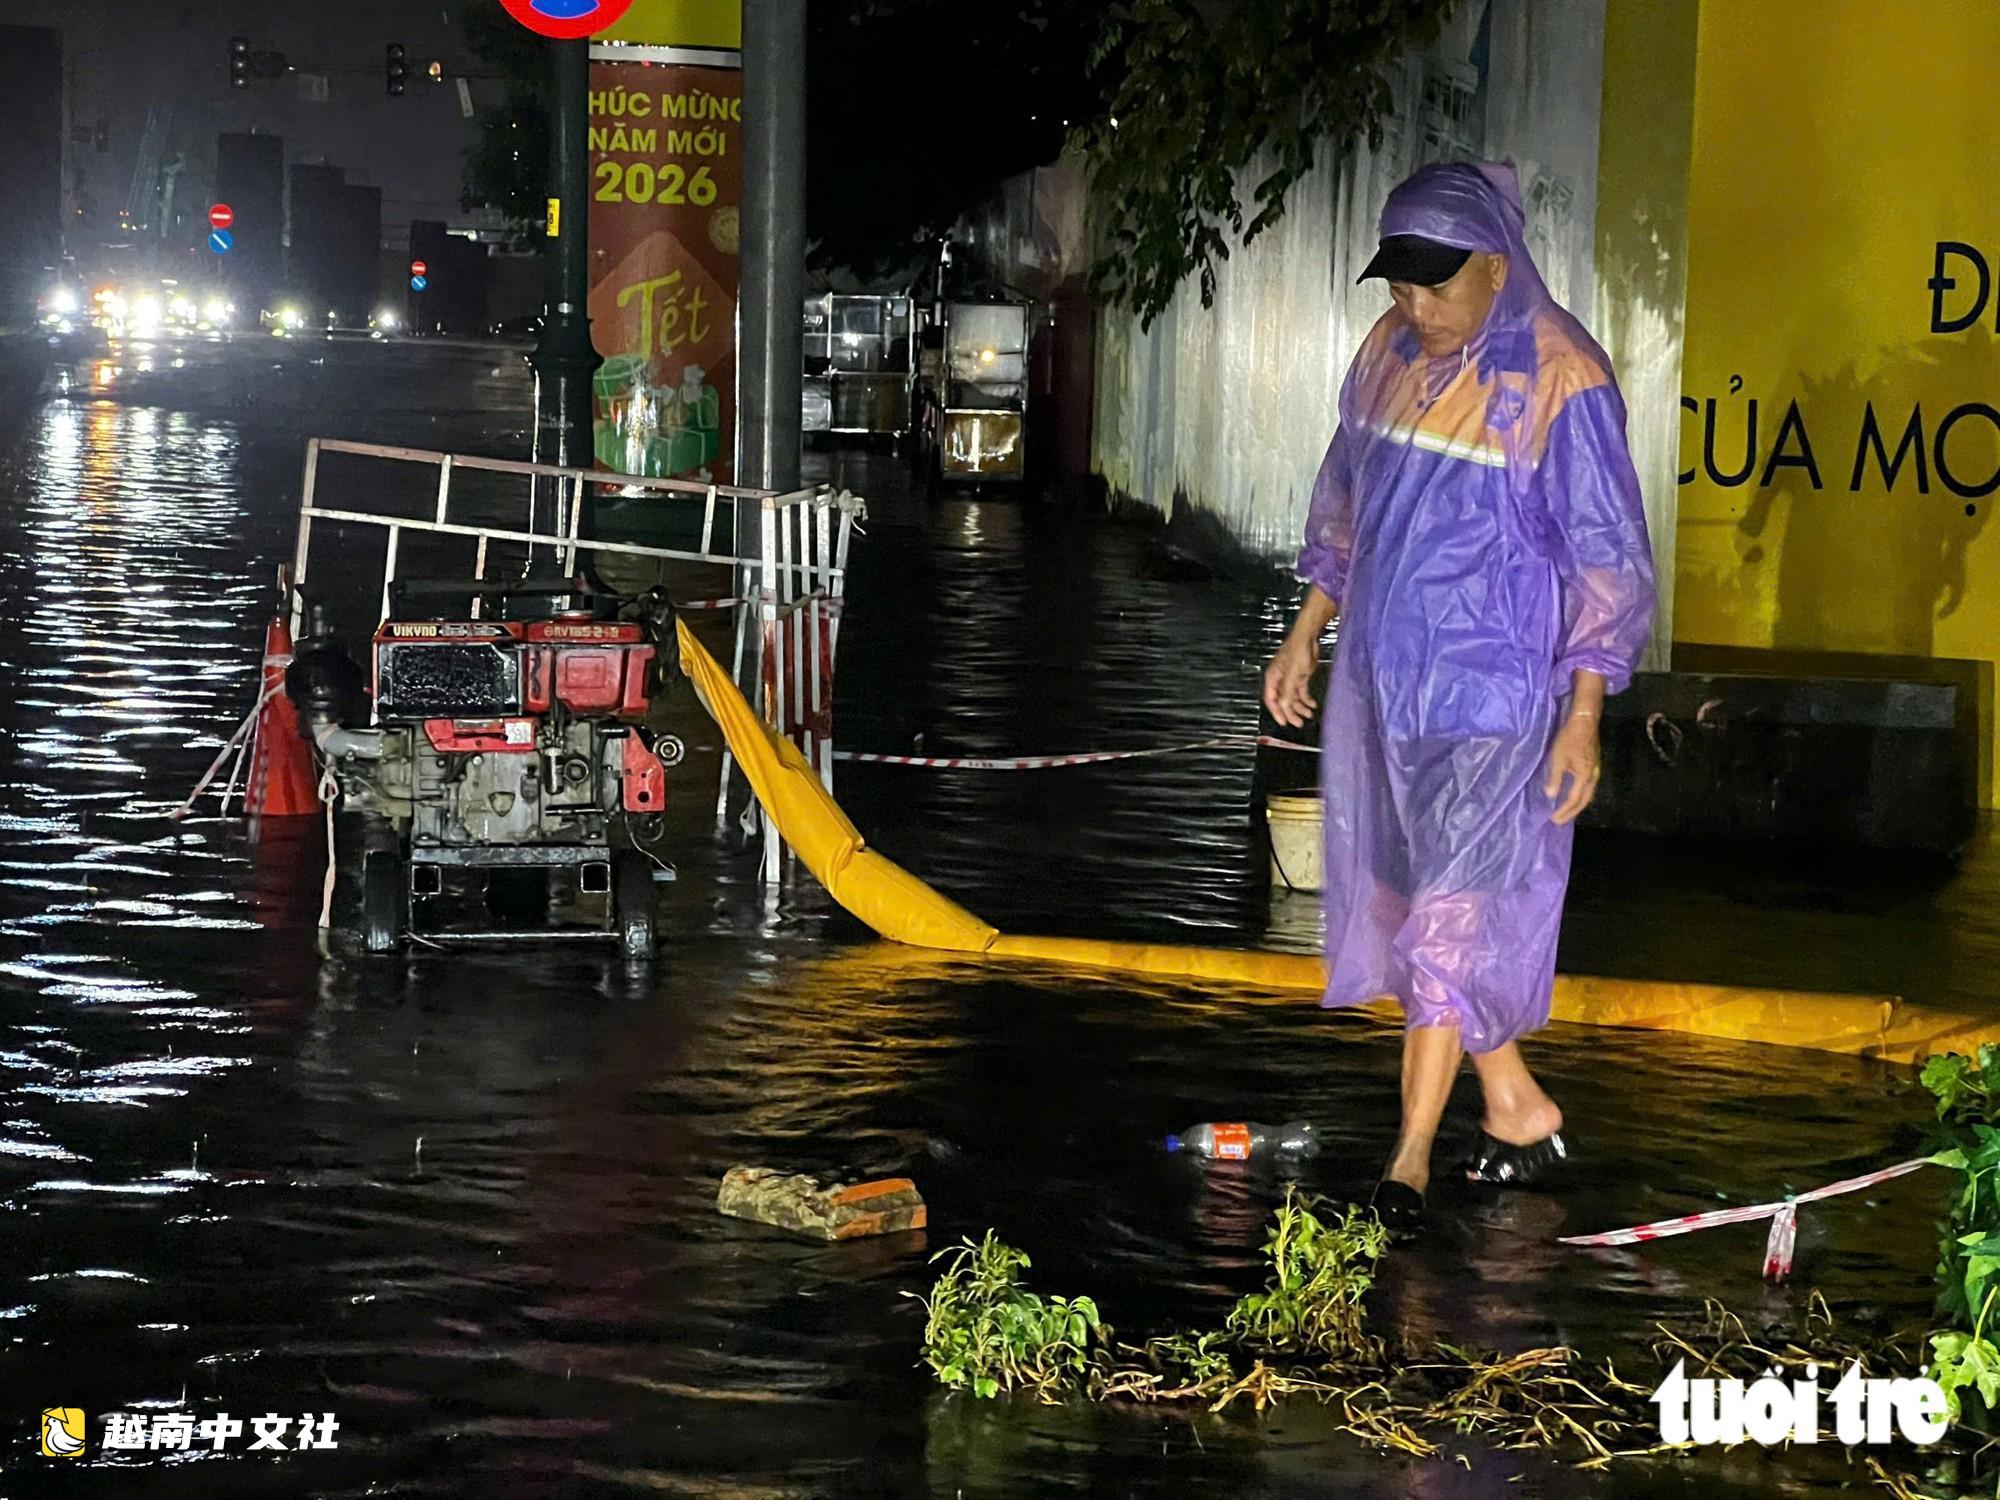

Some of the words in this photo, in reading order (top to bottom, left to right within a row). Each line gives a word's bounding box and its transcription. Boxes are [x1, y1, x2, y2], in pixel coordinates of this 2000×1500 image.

[589, 121, 656, 153] NĂM
[667, 125, 726, 156] MỚI
[595, 162, 717, 206] 2026
[617, 270, 710, 363] Tết
[1927, 241, 2000, 333] Đ
